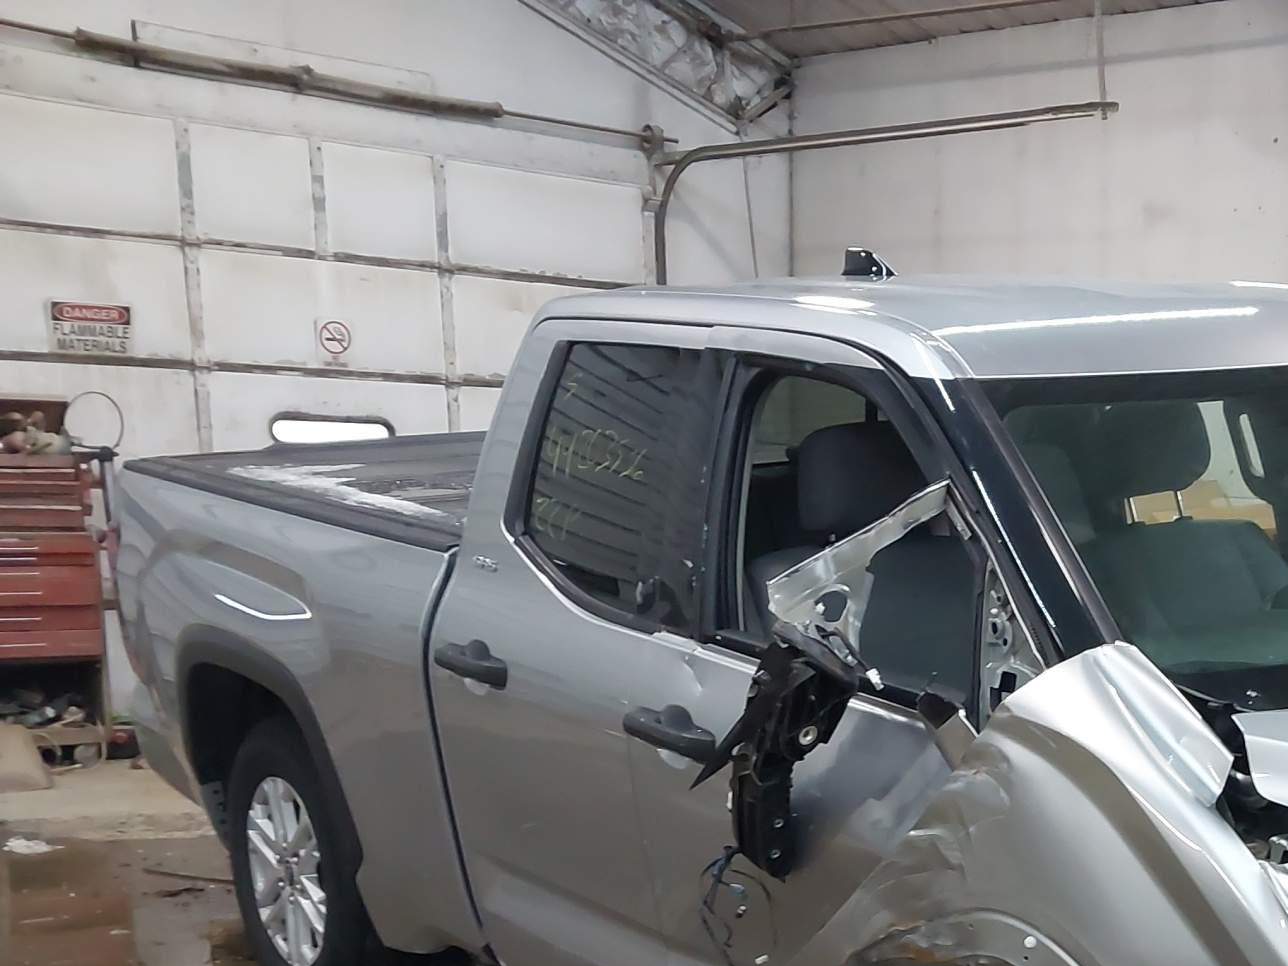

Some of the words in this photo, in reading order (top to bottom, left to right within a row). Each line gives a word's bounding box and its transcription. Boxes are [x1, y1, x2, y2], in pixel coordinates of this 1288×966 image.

[62, 306, 120, 320] DANGER
[53, 322, 130, 339] FLAMMABLE
[57, 338, 127, 353] MATERIALS
